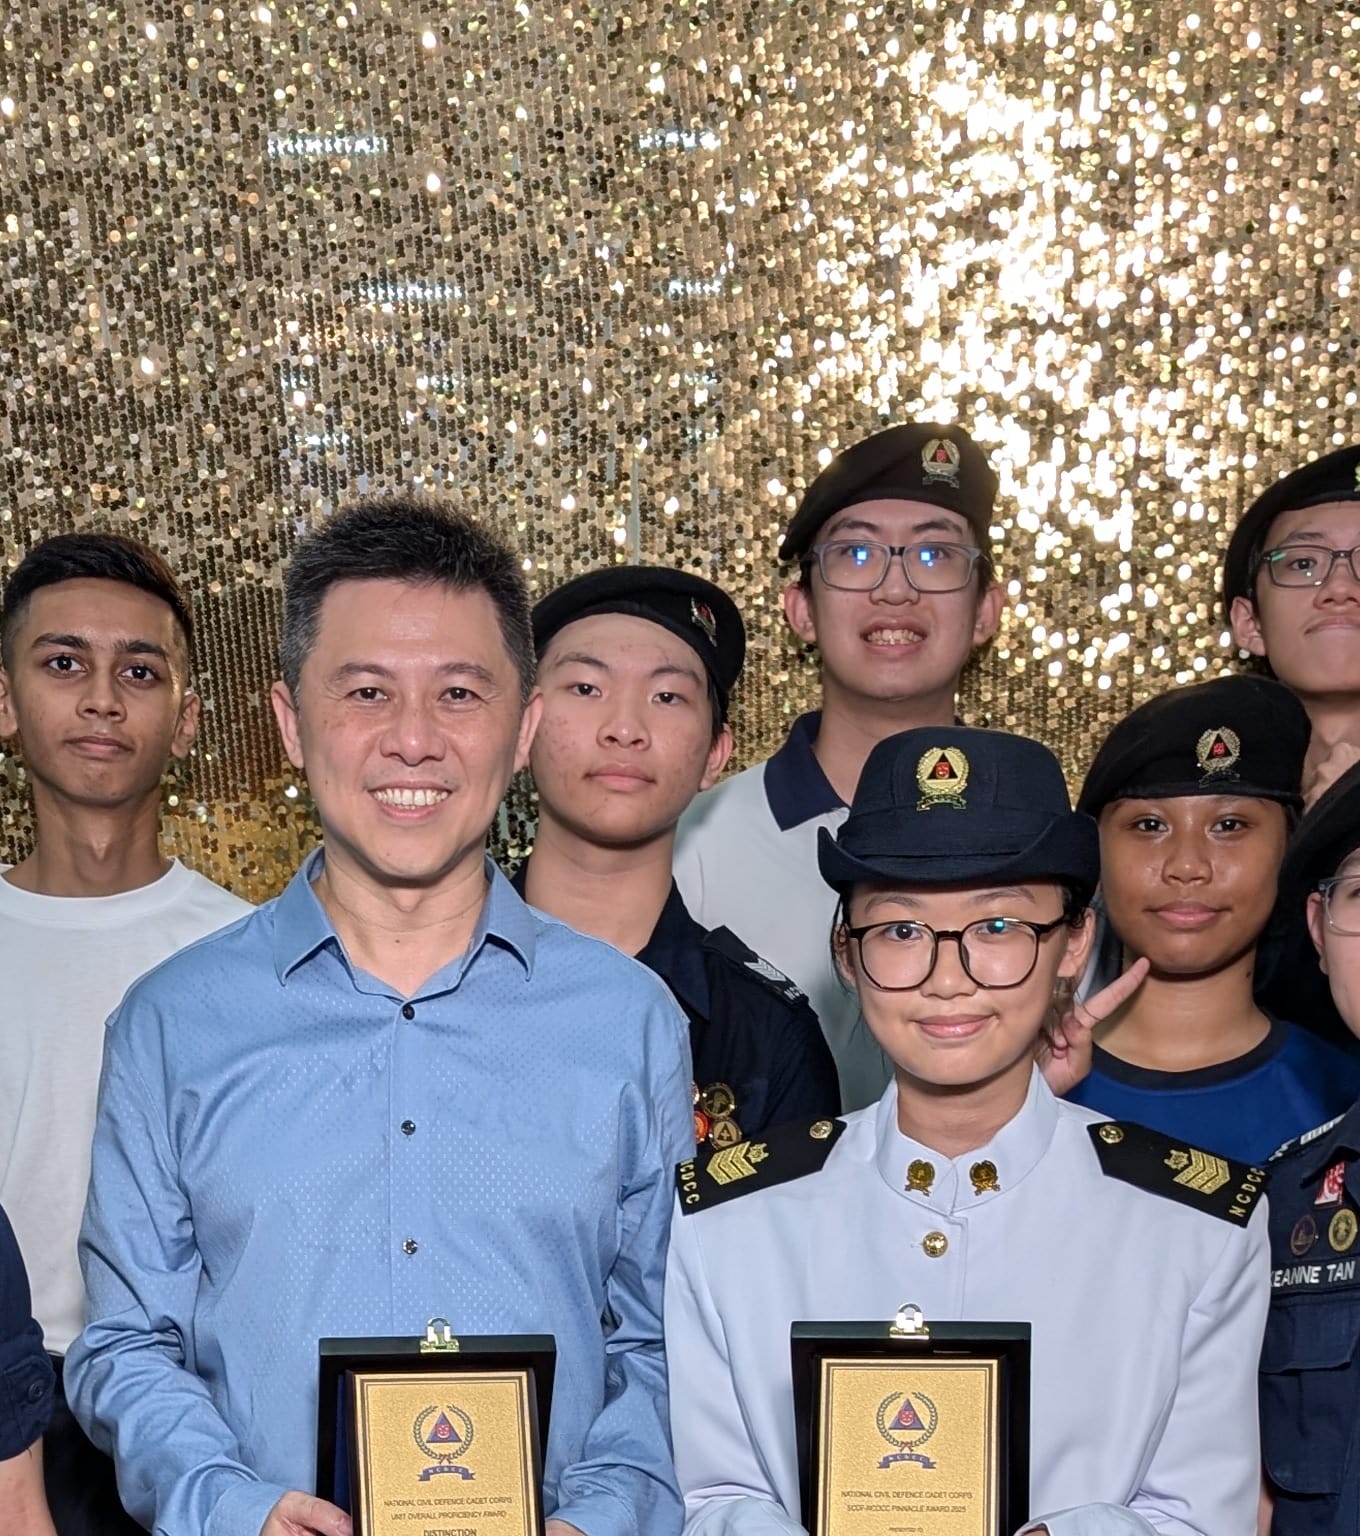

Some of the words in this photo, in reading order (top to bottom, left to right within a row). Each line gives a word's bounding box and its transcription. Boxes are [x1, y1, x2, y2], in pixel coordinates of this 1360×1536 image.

[1271, 1265, 1321, 1288] EANNE
[1326, 1260, 1356, 1283] TAN
[892, 1491, 923, 1499] DEFENCE
[924, 1491, 948, 1499] CADET
[948, 1491, 973, 1499] CORPS
[384, 1499, 416, 1507] NATIONAL
[417, 1498, 434, 1506] CIVIL
[434, 1498, 465, 1506] DEFENCE
[466, 1497, 488, 1505] CADET
[891, 1505, 925, 1513] PINNACLE
[926, 1505, 950, 1513] AWARD
[407, 1512, 437, 1520] OVERALL
[438, 1511, 482, 1519] PROFICIENCY
[482, 1510, 507, 1518] AWARD
